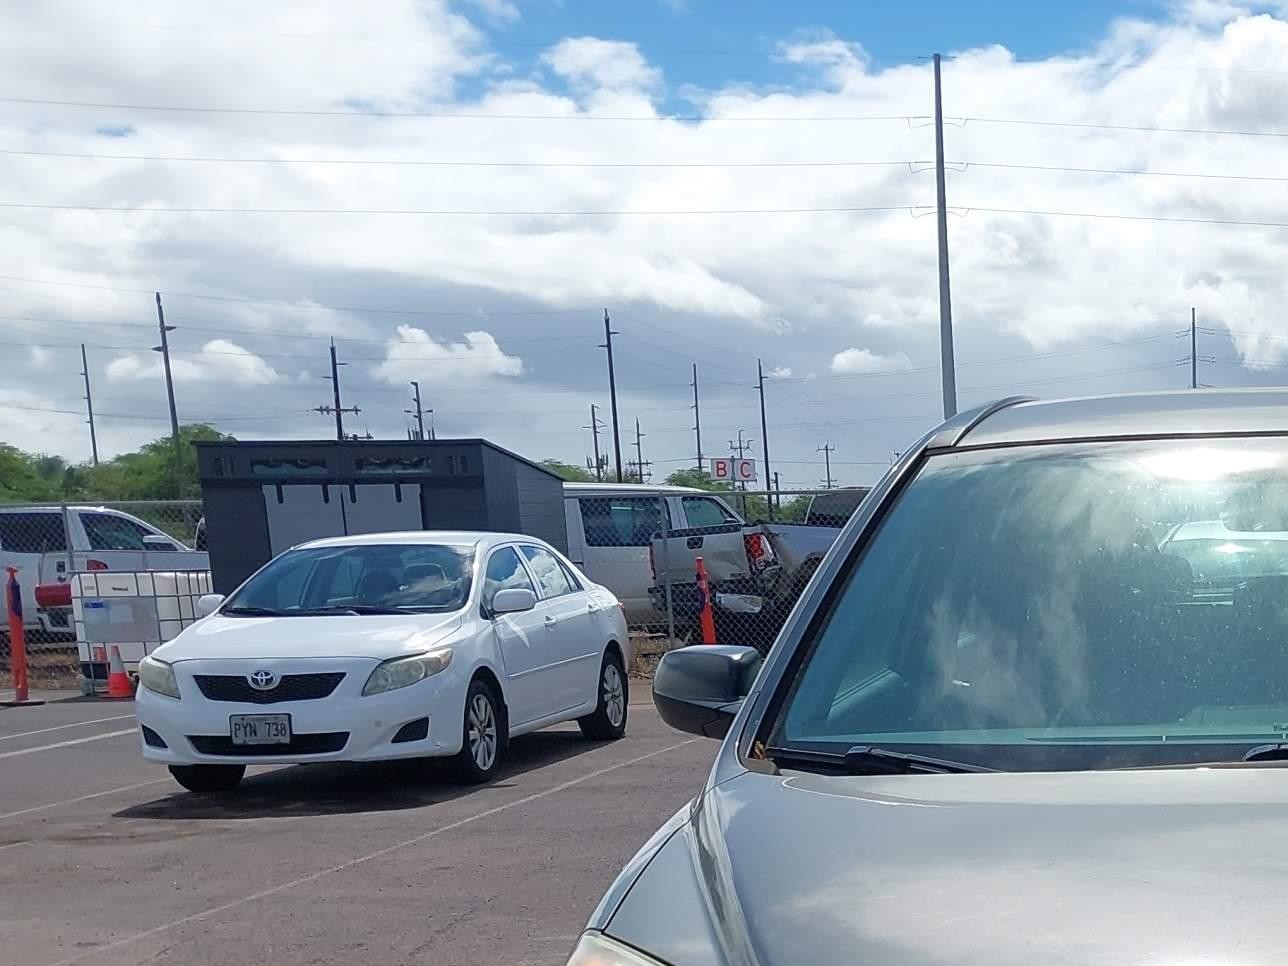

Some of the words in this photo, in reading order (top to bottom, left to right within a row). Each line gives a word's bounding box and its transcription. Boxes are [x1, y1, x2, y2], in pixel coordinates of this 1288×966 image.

[716, 461, 728, 477] B
[740, 461, 751, 478] C
[234, 722, 257, 738] PYN
[264, 722, 287, 737] 738
